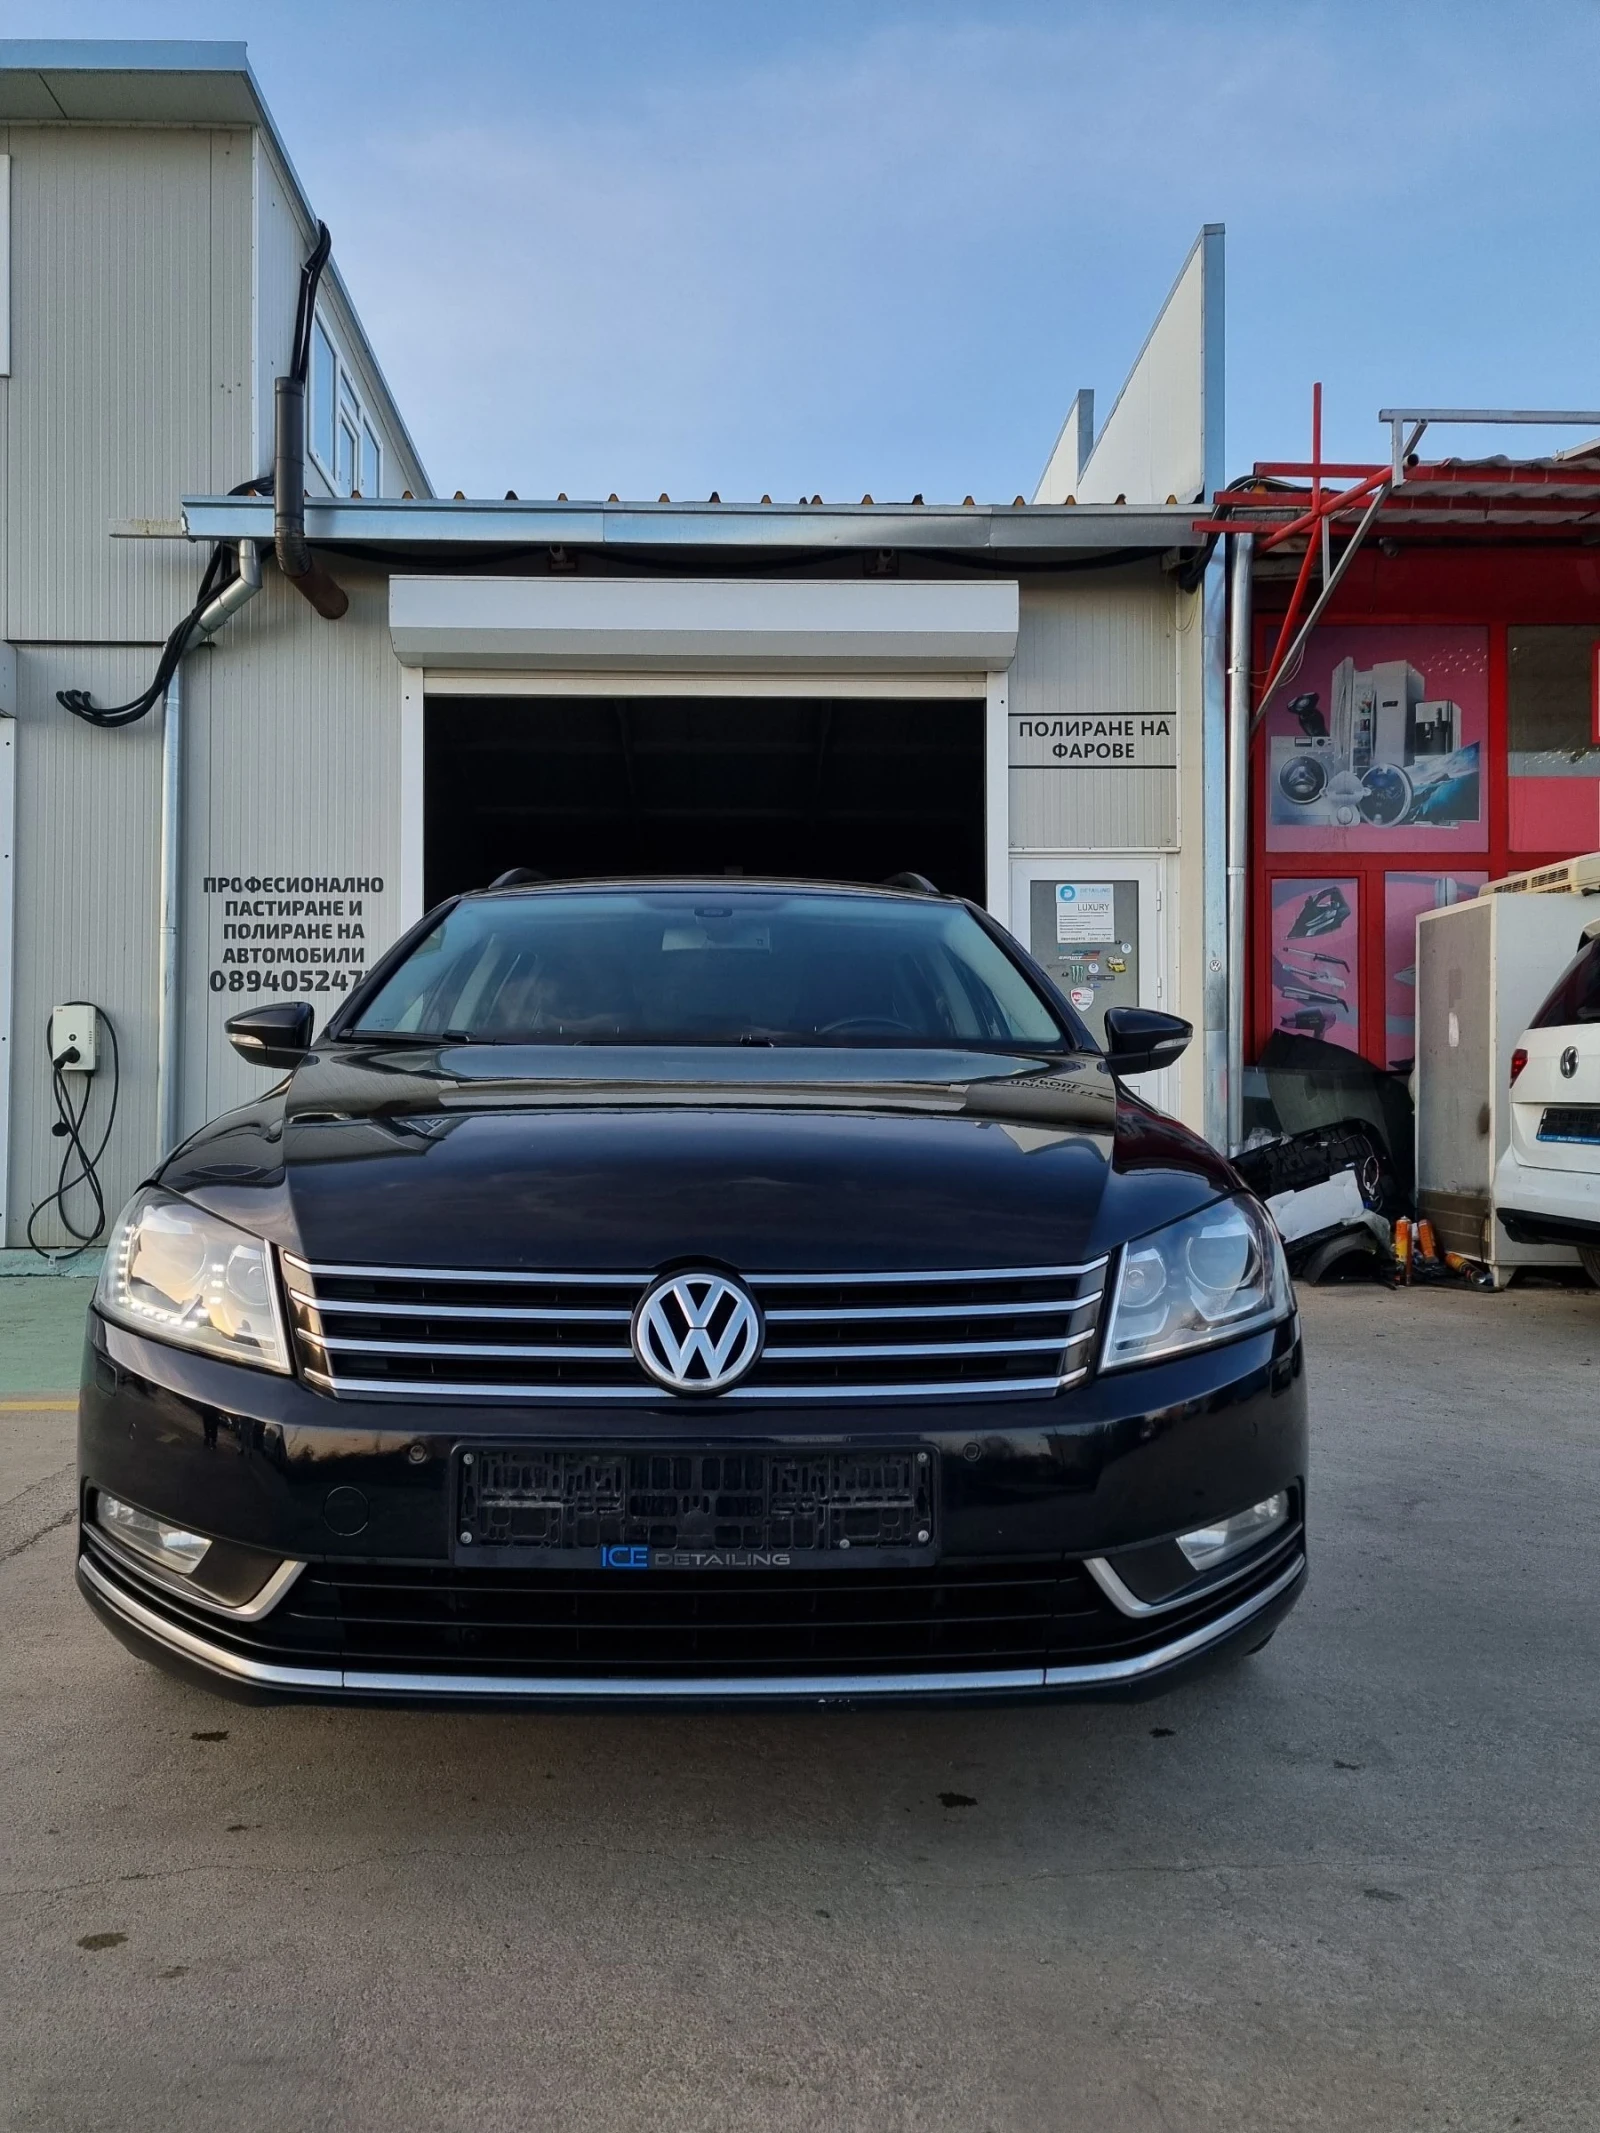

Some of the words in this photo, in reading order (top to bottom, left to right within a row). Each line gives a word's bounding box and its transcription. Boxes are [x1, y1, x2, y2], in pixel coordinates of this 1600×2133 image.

[1019, 721, 1134, 737] ПОЛИРАНЕ
[1141, 720, 1170, 736] НА
[1052, 743, 1135, 758] ФАРОВЕ
[203, 876, 384, 893] ПРОФЕСИОНАЛНО
[225, 901, 344, 916] ПАСТИРАНЕ
[349, 901, 363, 916] И
[1077, 903, 1110, 911] LUXURY
[223, 923, 333, 939] ПОЛИРАНЕ
[338, 923, 365, 939] НА
[222, 948, 365, 963] АВТОМОБИЛИ
[210, 970, 369, 992] 089405247
[602, 1547, 648, 1567] ICE
[655, 1553, 790, 1566] DETAILING
